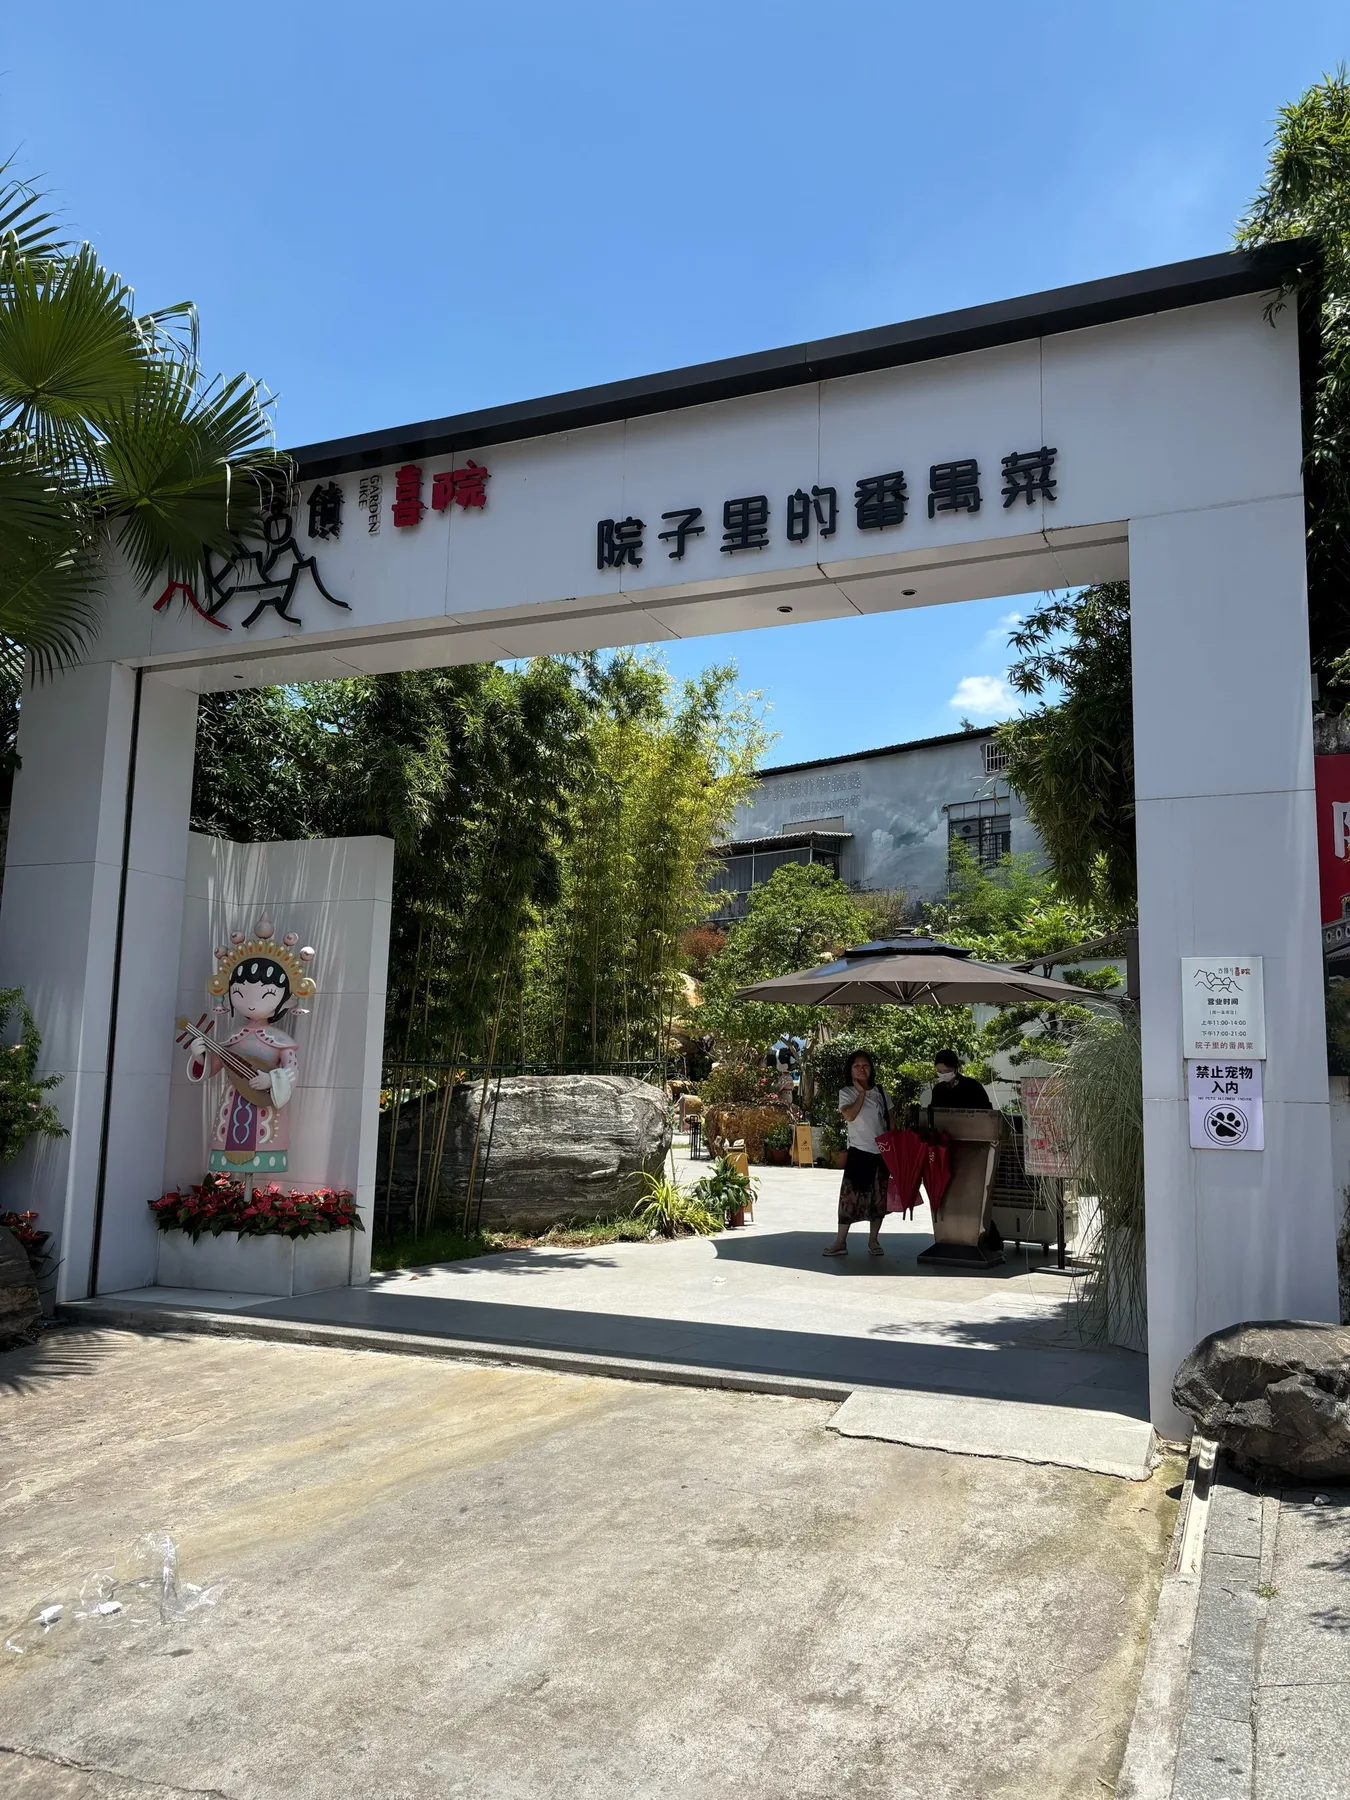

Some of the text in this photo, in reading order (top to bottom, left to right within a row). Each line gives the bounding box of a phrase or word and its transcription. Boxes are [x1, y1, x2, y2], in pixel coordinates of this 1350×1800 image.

[359, 478, 369, 509] LIKE
[368, 475, 381, 534] GARDEN
[392, 459, 489, 527] 喜院
[596, 446, 1059, 570] 院子里的番禺菜
[1207, 998, 1239, 1006] 营业时间
[1195, 1041, 1254, 1050] 院子里的番禺菜
[1196, 1065, 1253, 1079] 禁止宠物
[1211, 1080, 1239, 1095] 入内
